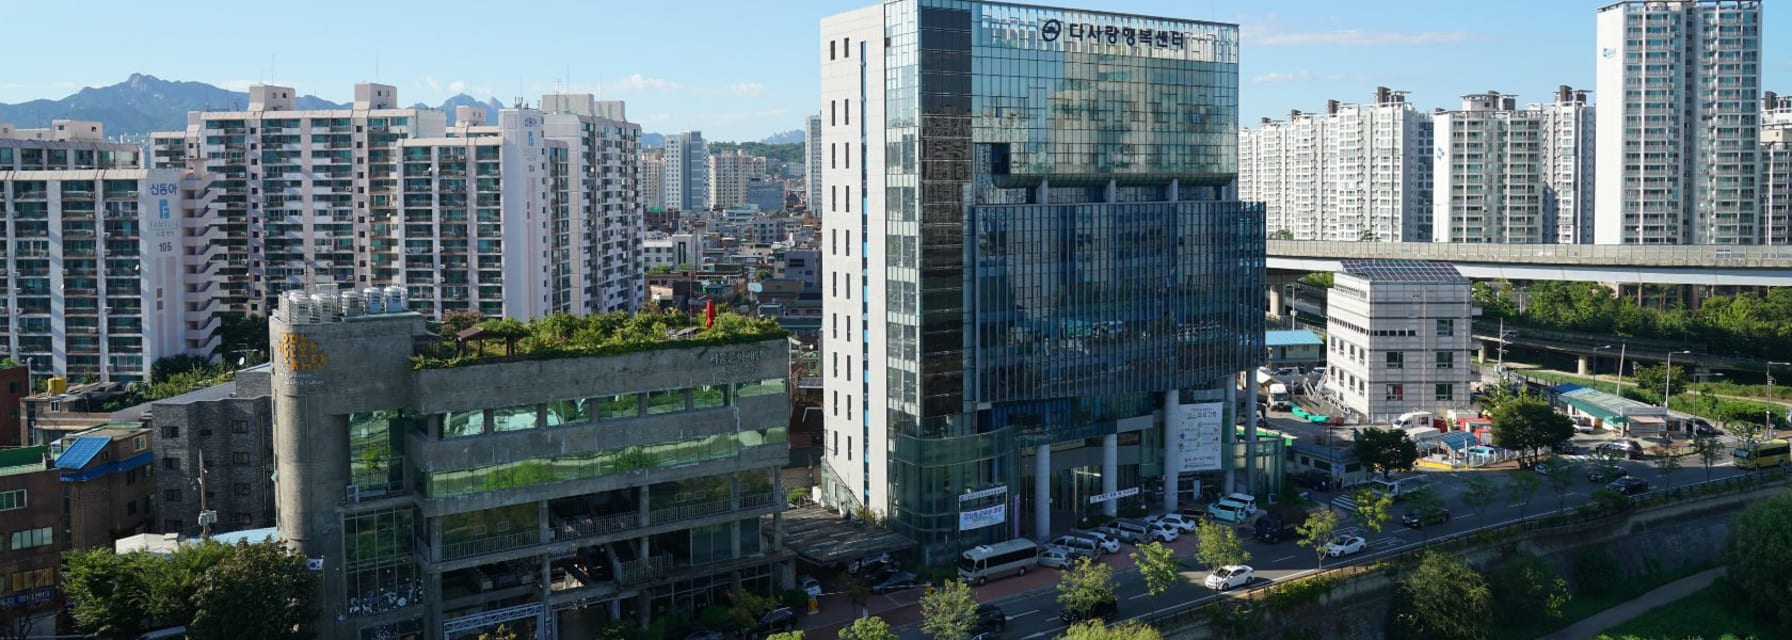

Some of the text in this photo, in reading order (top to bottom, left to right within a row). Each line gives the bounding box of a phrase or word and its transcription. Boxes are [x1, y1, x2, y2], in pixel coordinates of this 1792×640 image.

[1069, 22, 1184, 49] 다사랑행복센터
[150, 183, 178, 196] 신동아
[159, 242, 173, 252] 105
